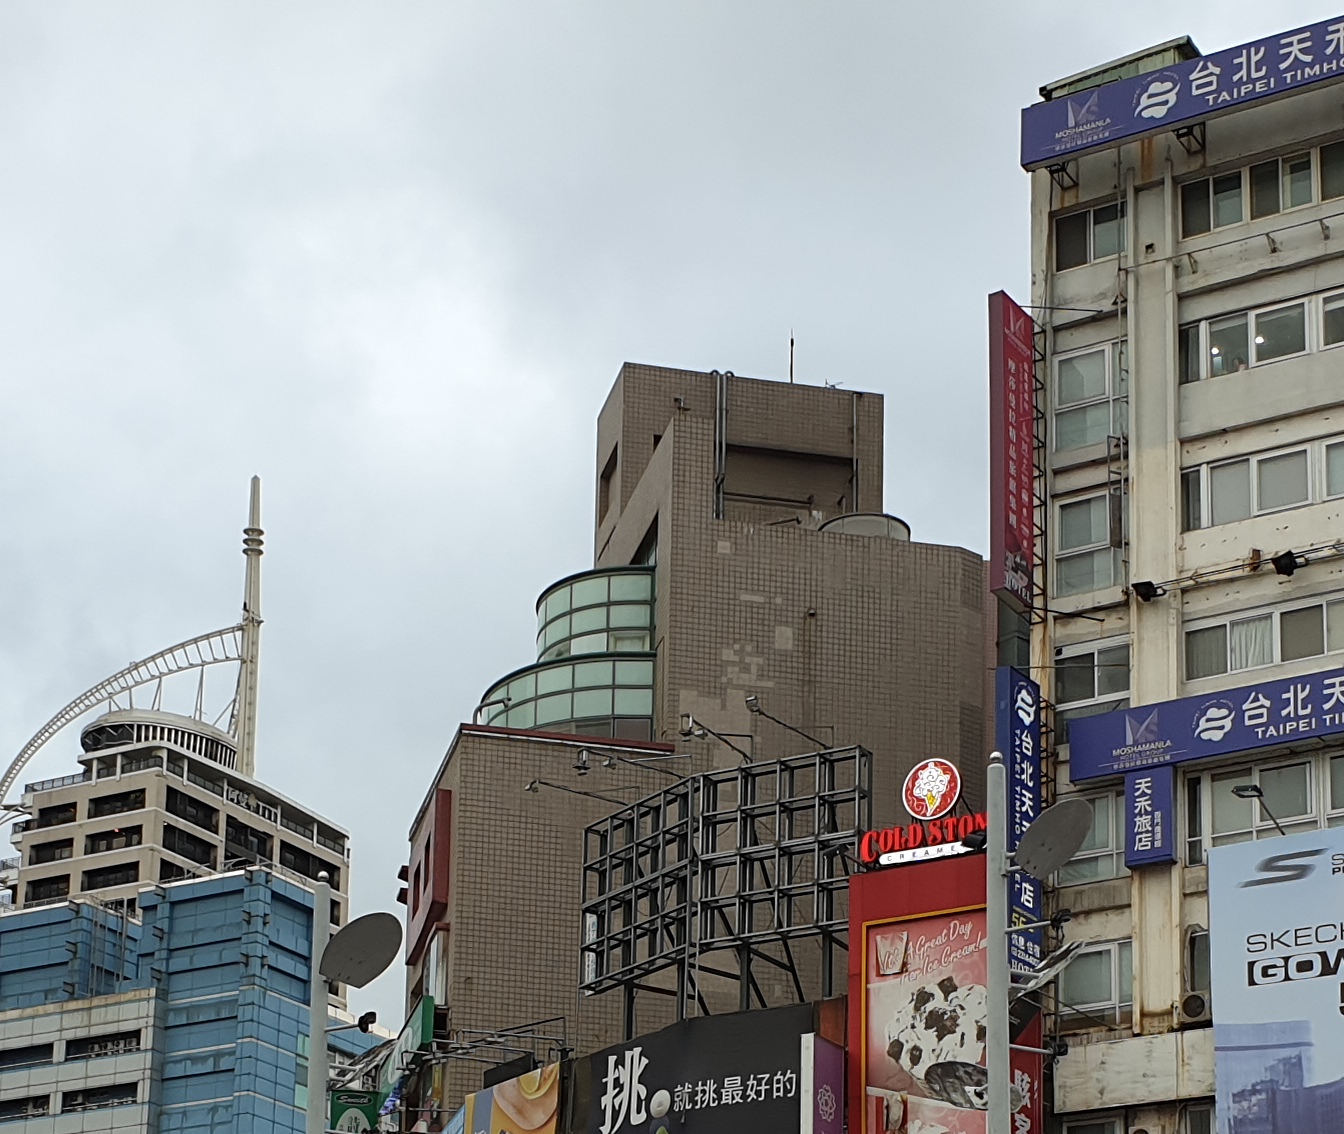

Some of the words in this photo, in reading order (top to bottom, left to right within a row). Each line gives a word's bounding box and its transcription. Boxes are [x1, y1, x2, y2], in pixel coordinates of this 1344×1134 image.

[1205, 77, 1276, 106] TAIPEI
[1255, 717, 1316, 740] TAIPEI
[1020, 730, 1036, 909] 台北天店
[1133, 778, 1152, 852] 天禾旅店
[861, 822, 924, 863] COLD
[928, 813, 989, 846] STON
[886, 844, 956, 862] CREAME
[914, 930, 948, 960] Great
[950, 920, 973, 941] Day
[672, 1070, 797, 1113] 就挑最好的
